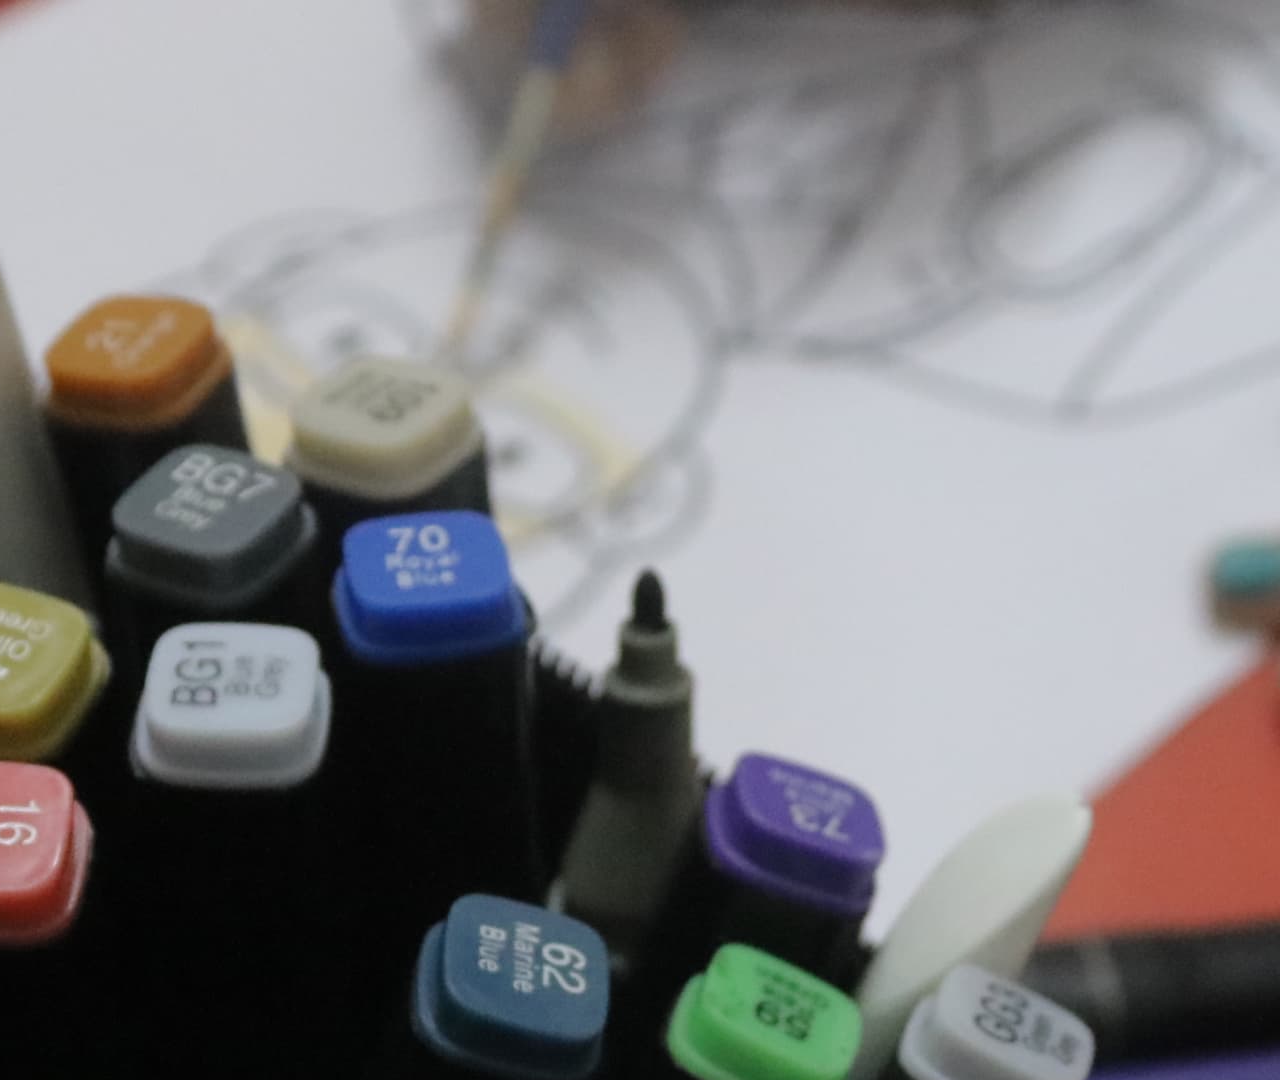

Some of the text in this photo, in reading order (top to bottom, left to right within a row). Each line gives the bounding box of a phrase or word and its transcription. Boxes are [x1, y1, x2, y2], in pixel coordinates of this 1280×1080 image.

[170, 453, 278, 501] BG7
[386, 524, 449, 556] 70
[395, 569, 457, 590] Blue
[170, 640, 227, 710] BG1
[478, 924, 507, 974] Blue
[513, 923, 541, 995] Marine
[541, 942, 587, 995] 62
[973, 983, 1030, 1043] GG3
